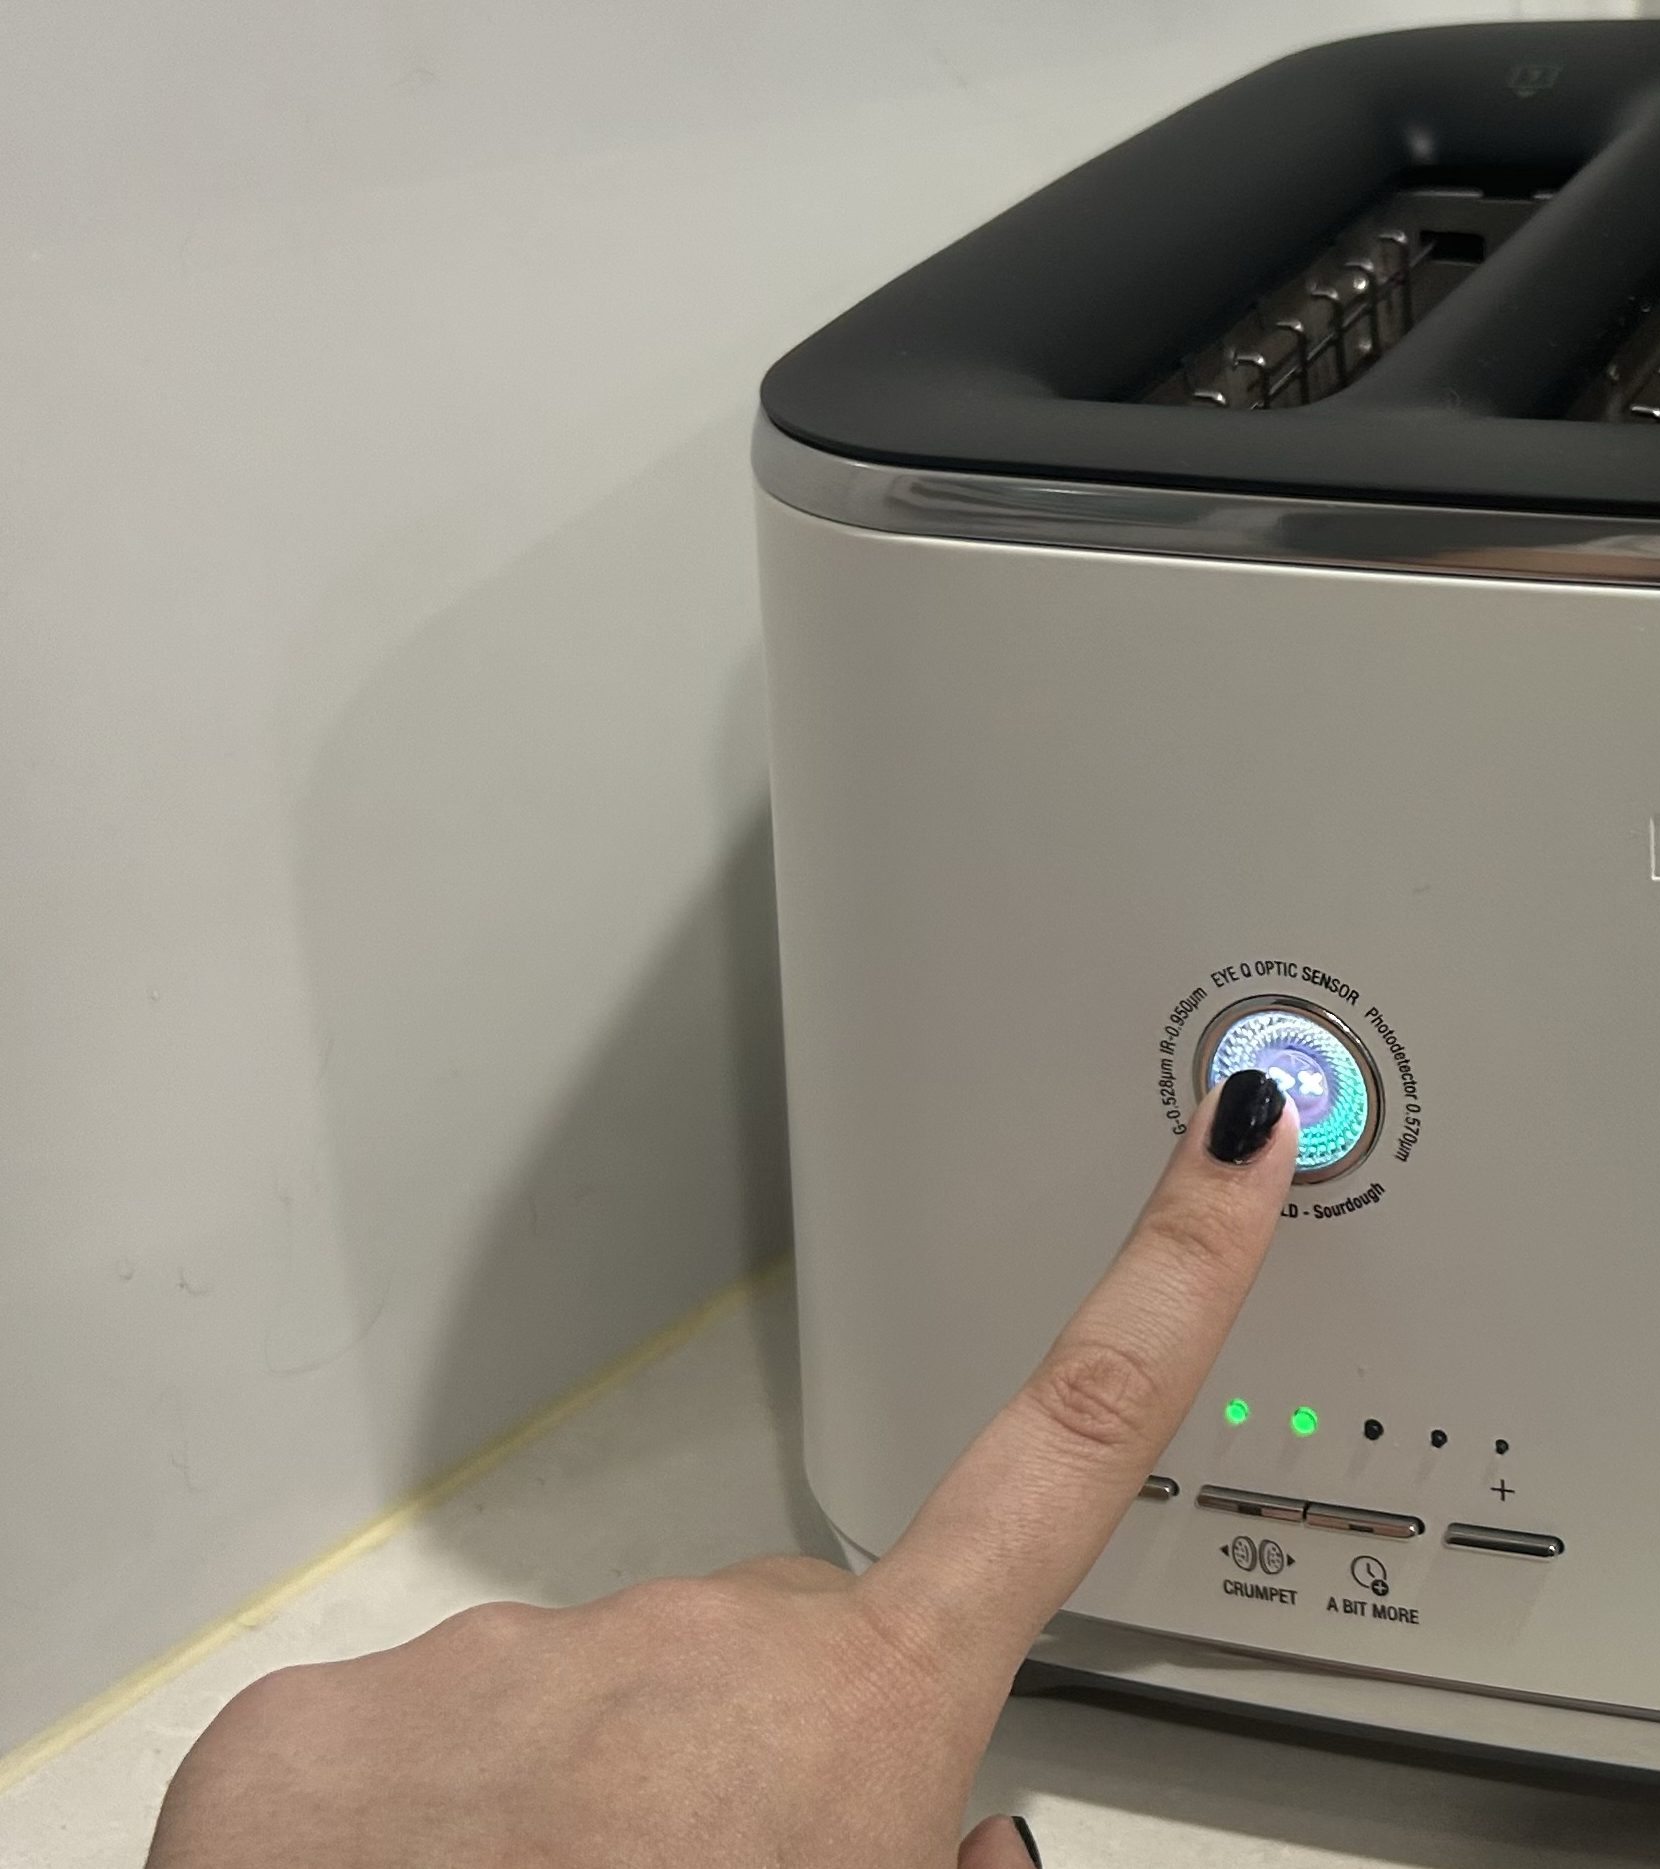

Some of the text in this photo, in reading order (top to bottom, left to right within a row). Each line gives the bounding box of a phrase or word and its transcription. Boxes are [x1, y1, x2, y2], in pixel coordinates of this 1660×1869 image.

[1210, 960, 1360, 1006] EYE Q OPTIC SENSOR
[1364, 1006, 1418, 1100] Photodetector
[1280, 1202, 1298, 1219] LD
[1313, 1182, 1386, 1219] Sourdough
[1223, 1578, 1298, 1605] CRUMPET
[1326, 1597, 1420, 1625] A BIT MORE
